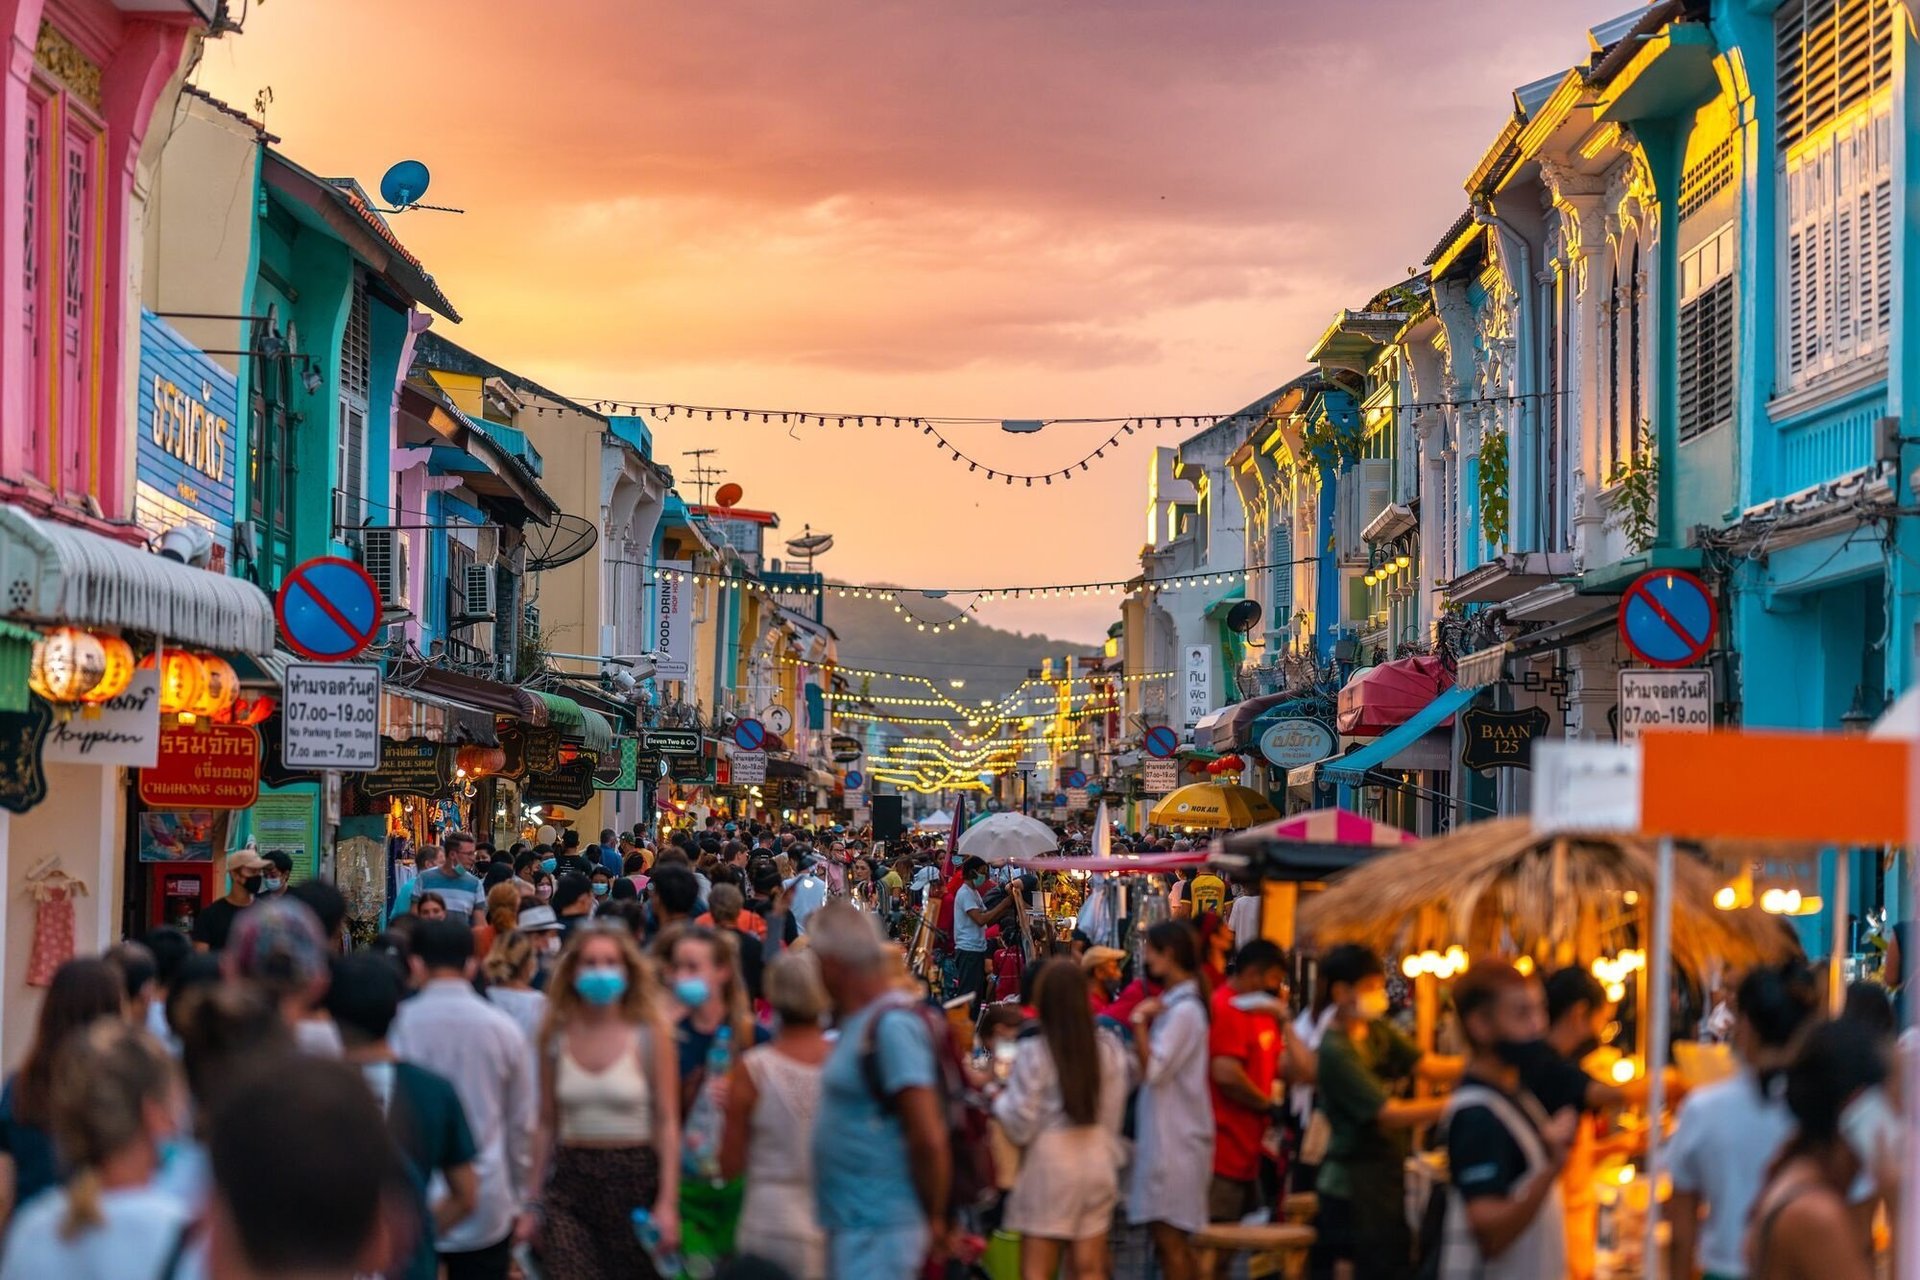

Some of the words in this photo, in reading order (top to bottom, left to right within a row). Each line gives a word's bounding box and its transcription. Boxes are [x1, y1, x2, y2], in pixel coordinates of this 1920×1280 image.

[660, 569, 671, 653] FOOD+DRINKS
[1190, 670, 1206, 682] กิน
[290, 674, 375, 704] ห้ามจอดวันคู่
[1624, 675, 1707, 699] ห้ามจอดวันคี่
[289, 702, 375, 722] 07.00-19.00
[1624, 706, 1707, 724] 07.00-19.00
[289, 727, 299, 737] No
[303, 728, 331, 740] Parking
[334, 728, 352, 738] Even
[355, 729, 373, 740] Days
[1482, 725, 1530, 738] BAAN
[160, 728, 254, 756] รรมจักร
[647, 737, 667, 745] Eleven
[1495, 740, 1519, 754] 125
[289, 742, 310, 758] 7.00
[358, 750, 373, 760] pm
[379, 760, 396, 768] OKE
[397, 760, 413, 768] DEE
[414, 760, 435, 768] SHOP
[214, 784, 253, 798] SHOP
